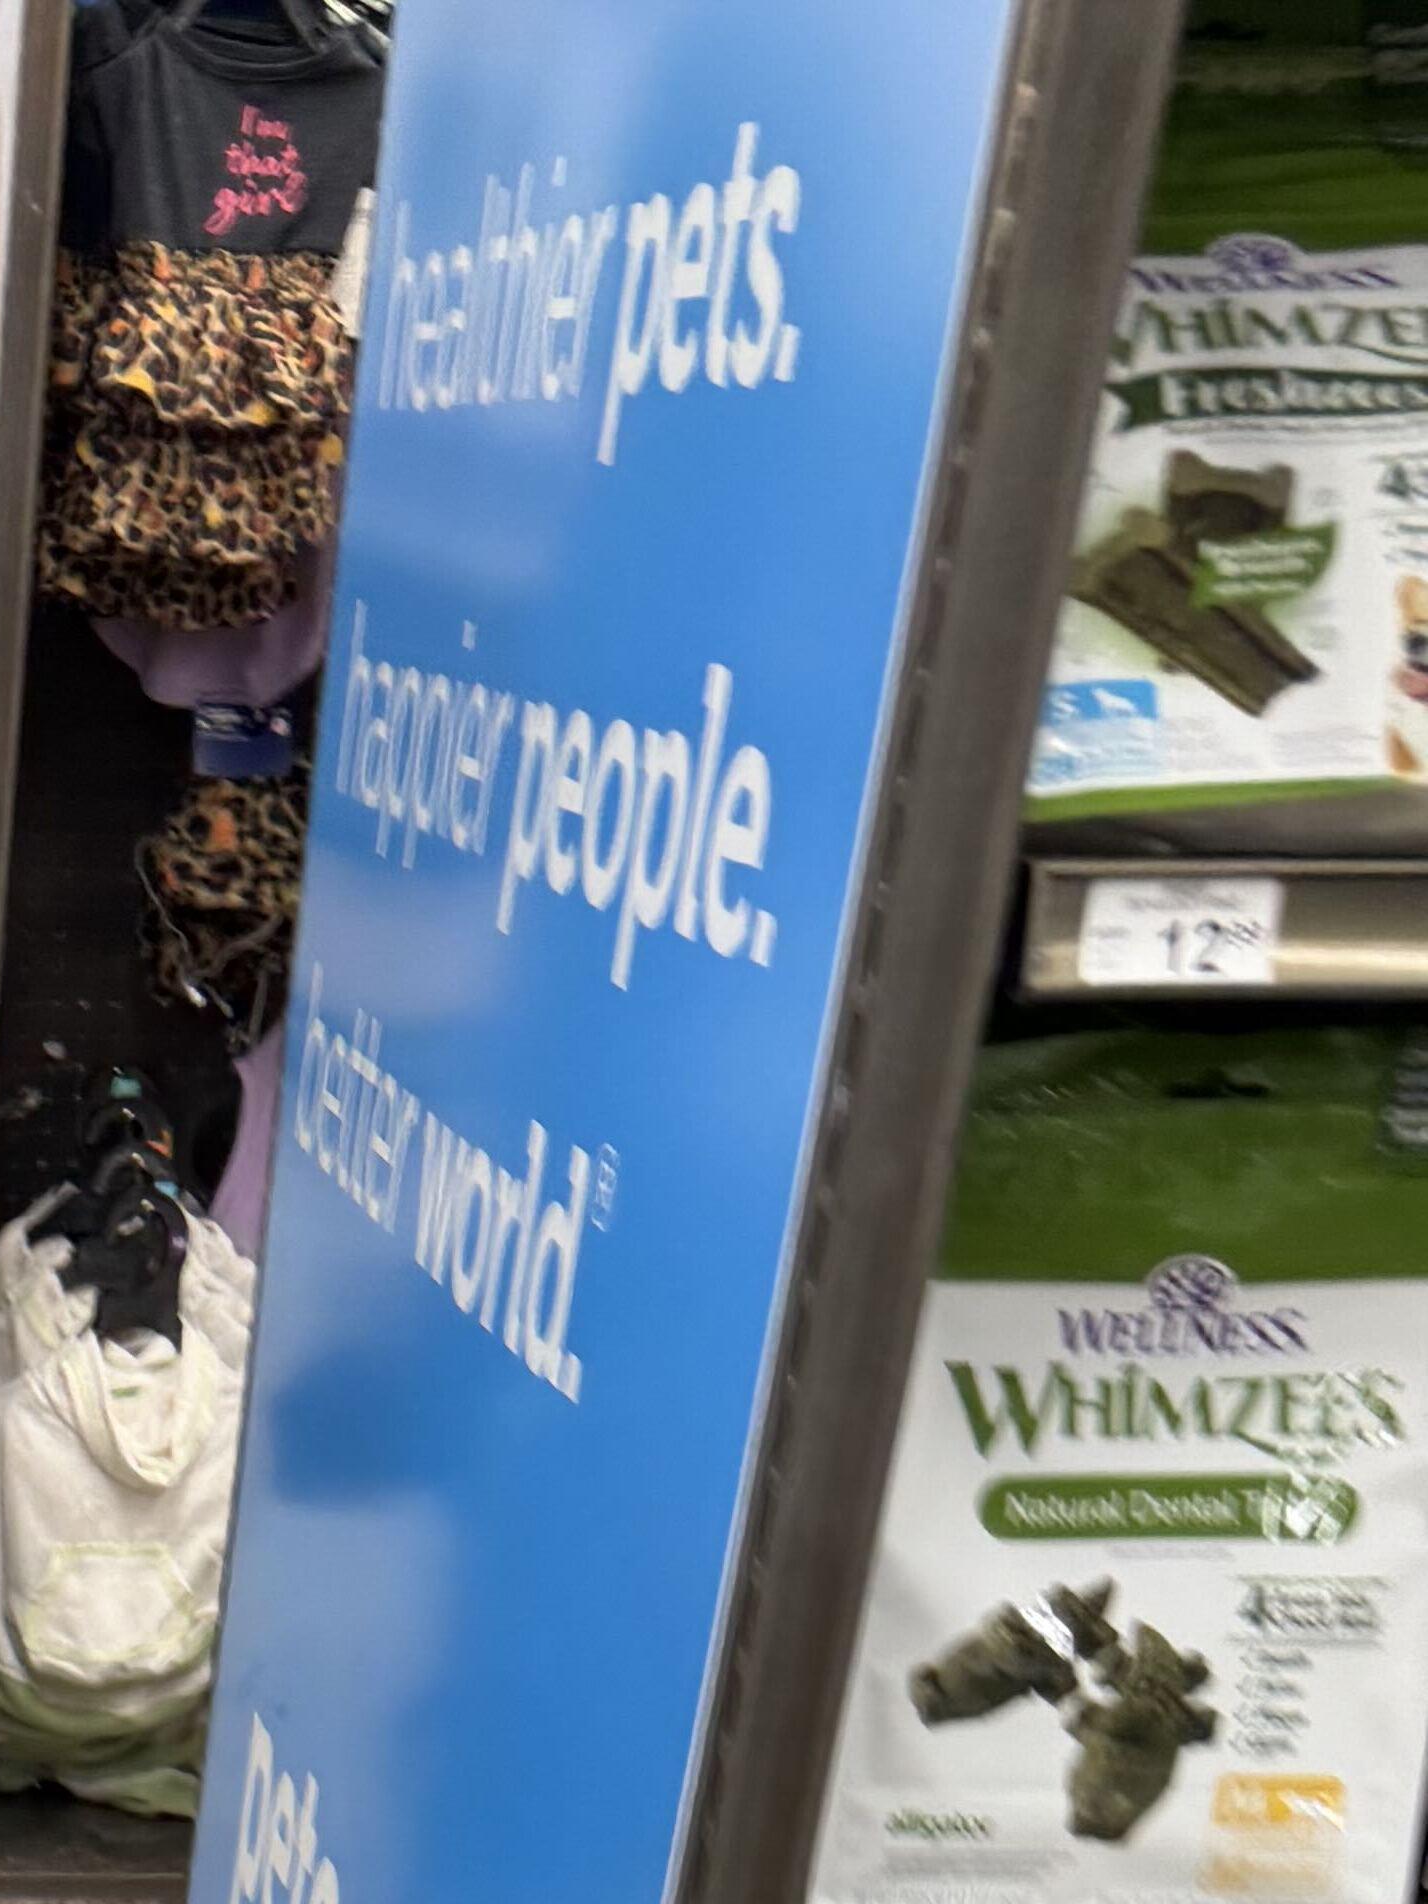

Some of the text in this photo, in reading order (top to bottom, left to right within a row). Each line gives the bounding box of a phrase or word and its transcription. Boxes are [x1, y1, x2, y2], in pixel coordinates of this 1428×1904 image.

[378, 121, 801, 466] healthier pets.
[337, 600, 778, 992] happier people.
[293, 961, 590, 1405] better world.
[944, 1359, 1406, 1463] WHIMZEES
[1056, 1307, 1311, 1355] WELLNESS
[1004, 1490, 1129, 1530] Natural
[1128, 1490, 1243, 1530] Dental
